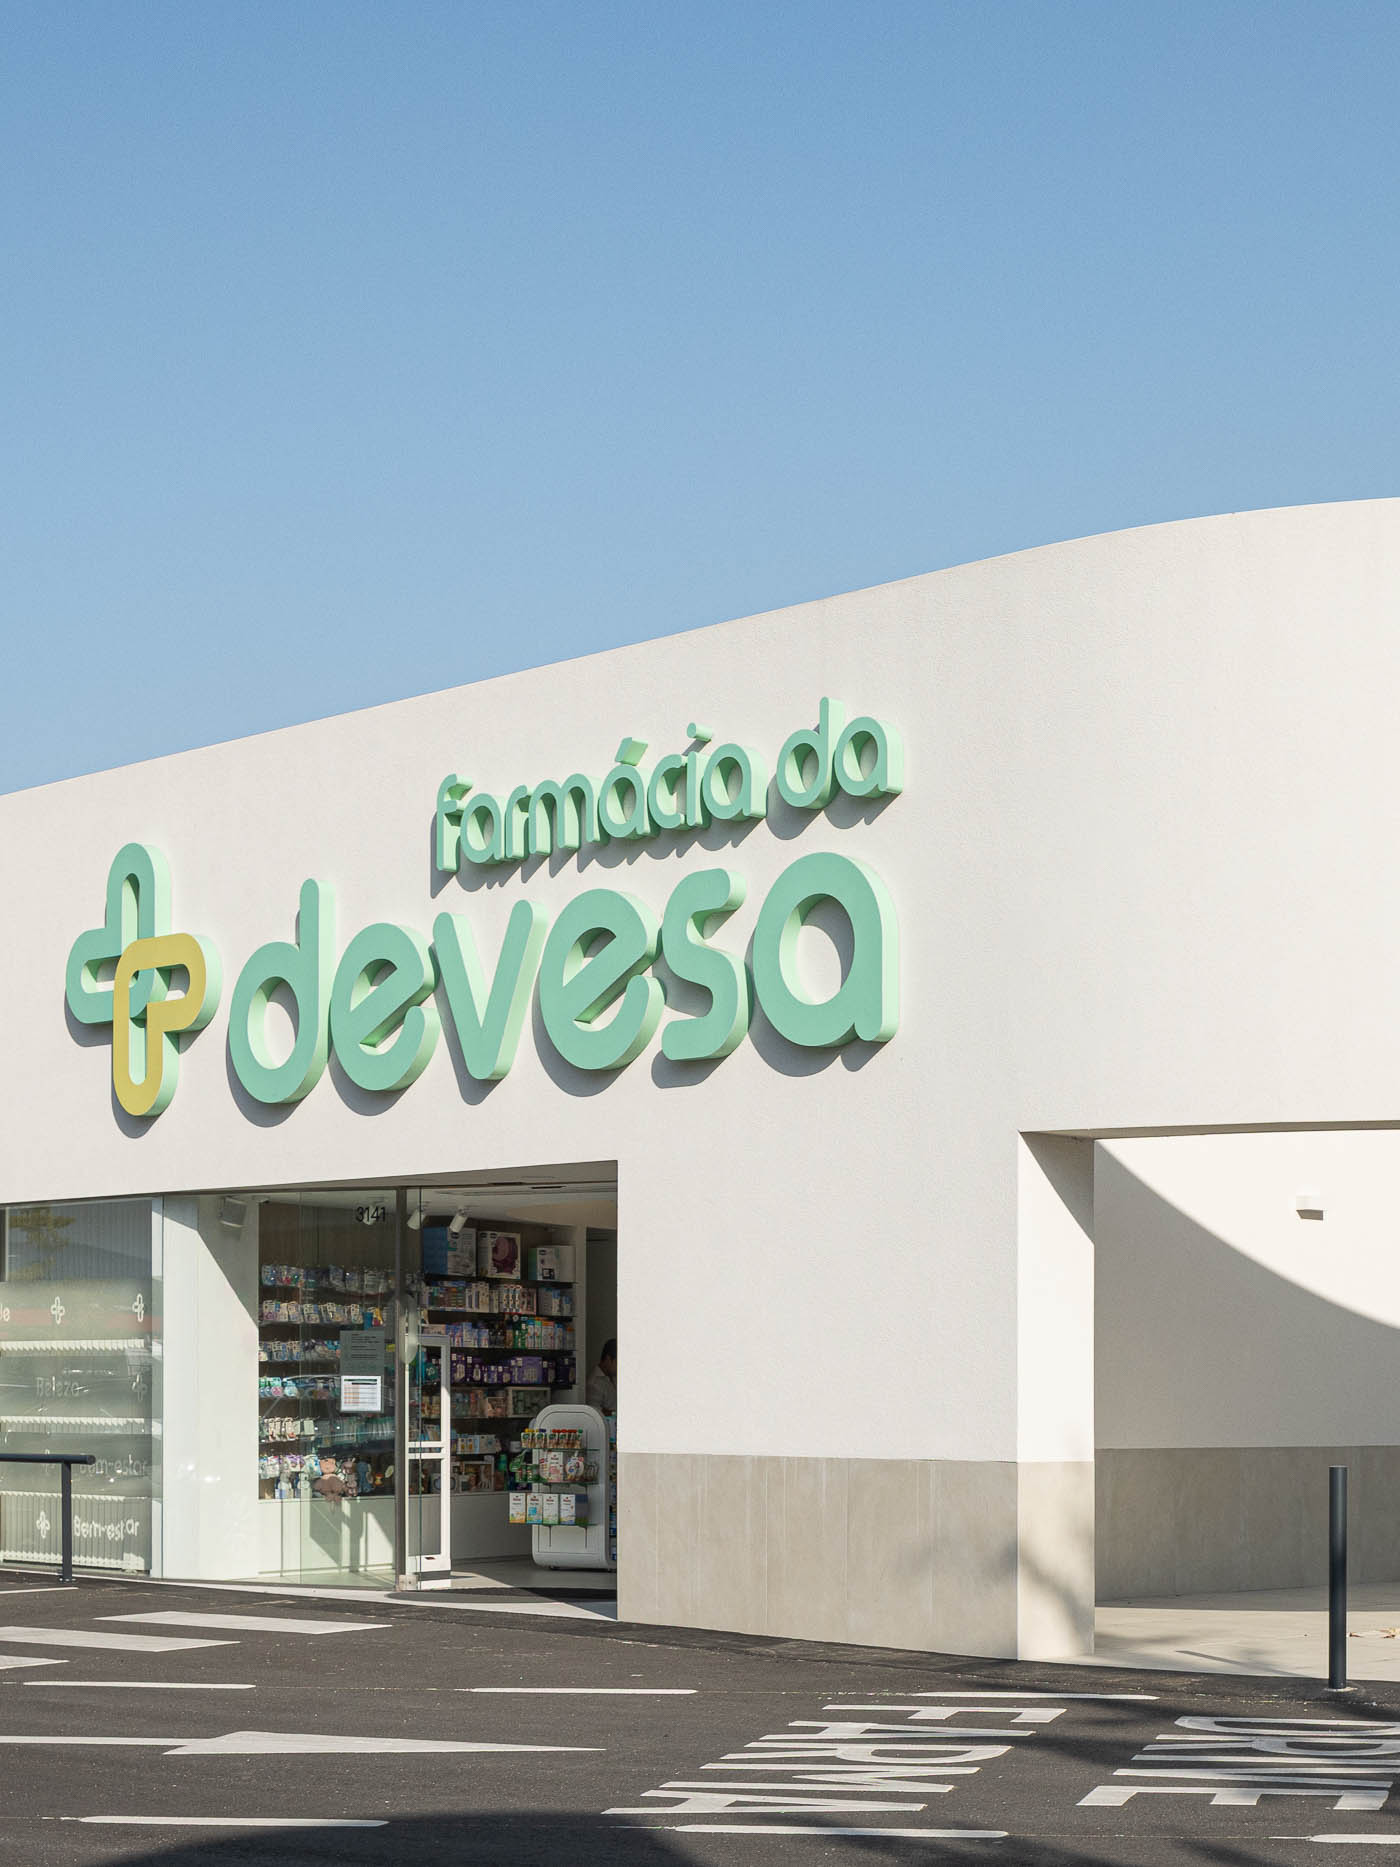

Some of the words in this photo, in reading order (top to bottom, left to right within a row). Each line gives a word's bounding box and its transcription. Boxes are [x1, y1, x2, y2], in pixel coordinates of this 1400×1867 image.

[436, 722, 767, 872] farmácia
[776, 696, 905, 809] da
[229, 851, 900, 1104] devesa
[355, 1205, 386, 1223] 3141
[601, 1703, 1068, 1815] FARMA
